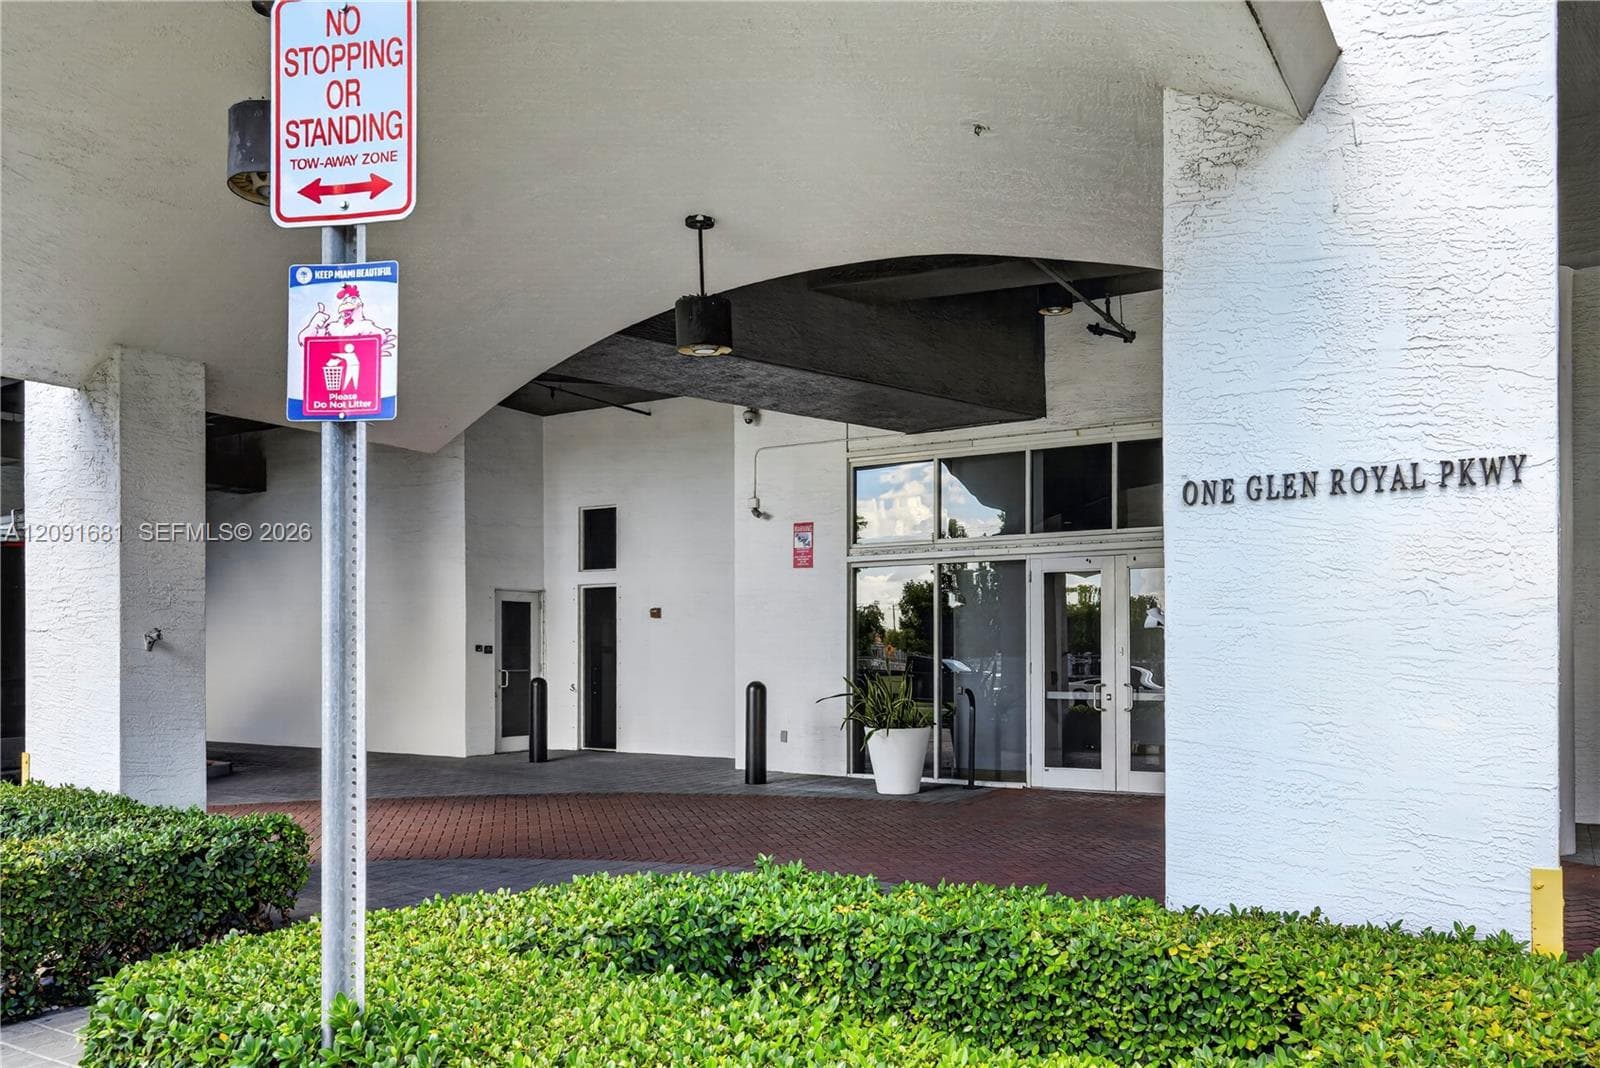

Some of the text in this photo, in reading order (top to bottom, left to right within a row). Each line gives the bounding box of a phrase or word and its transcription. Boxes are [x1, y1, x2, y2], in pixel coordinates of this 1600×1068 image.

[326, 5, 361, 37] NO
[284, 37, 403, 77] STOPPING
[326, 78, 361, 109] OR
[285, 110, 403, 149] STANDING
[290, 150, 398, 170] TOW-AWAY ZONE
[314, 267, 392, 279] KEEP MIAMI BEAUTIFUL
[313, 400, 371, 409] Do Not Litter
[1182, 454, 1527, 506] ONE GLEN ROYAL PKWY
